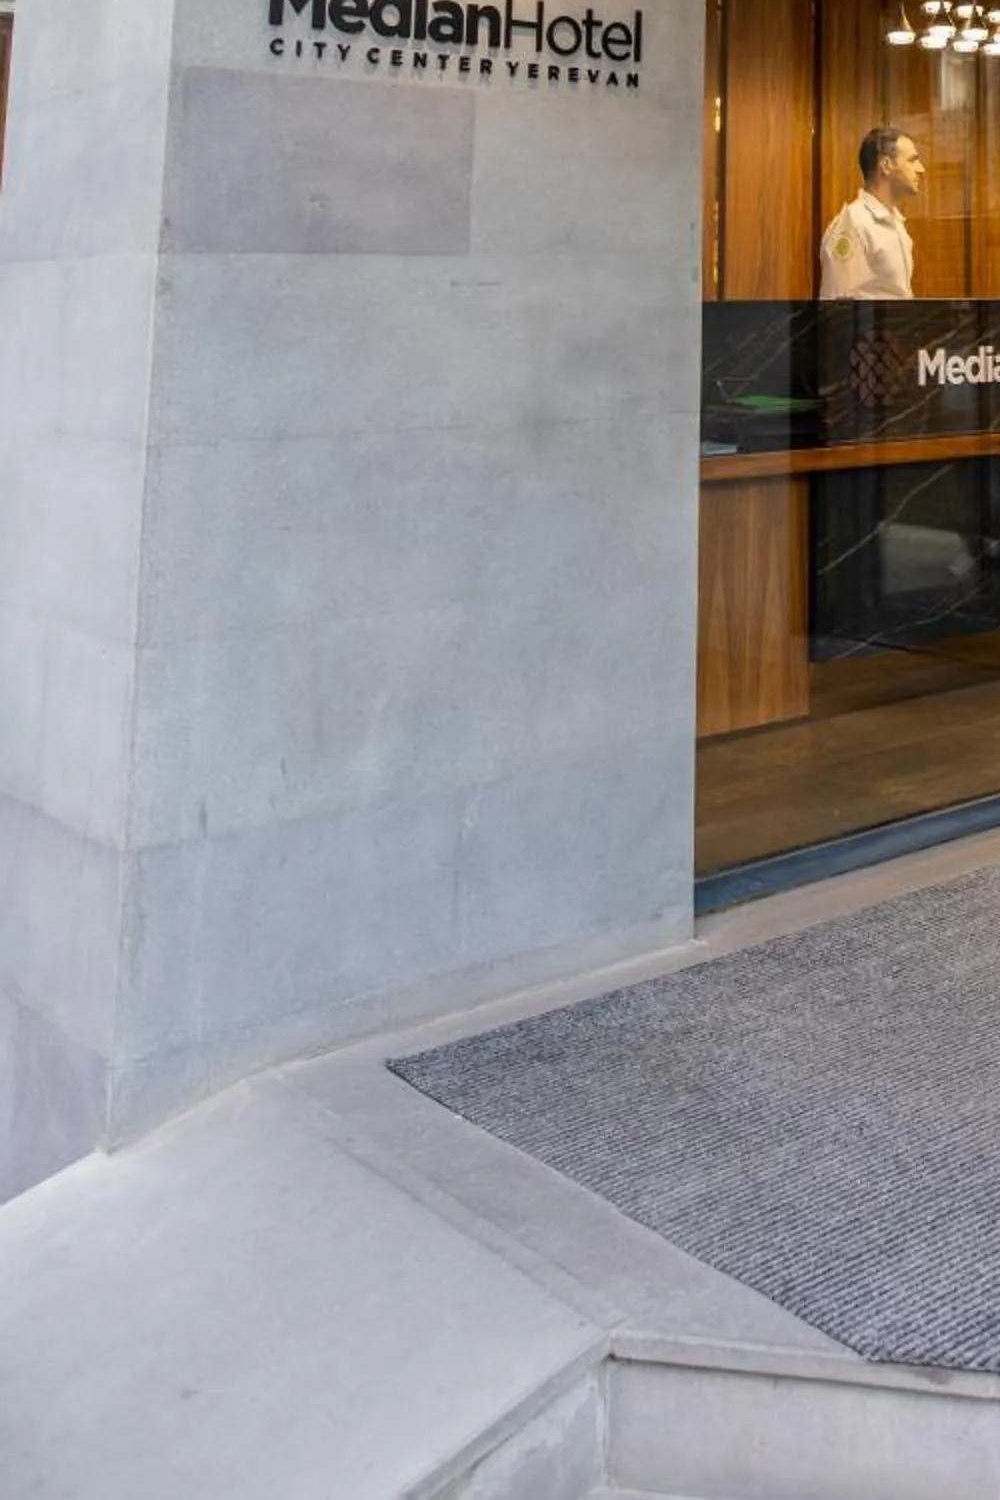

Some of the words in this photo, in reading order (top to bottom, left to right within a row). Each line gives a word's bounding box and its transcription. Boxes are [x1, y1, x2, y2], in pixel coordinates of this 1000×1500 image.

[269, 37, 351, 62] CITY
[366, 47, 493, 76] CENTER
[506, 60, 640, 89] YEREVAN
